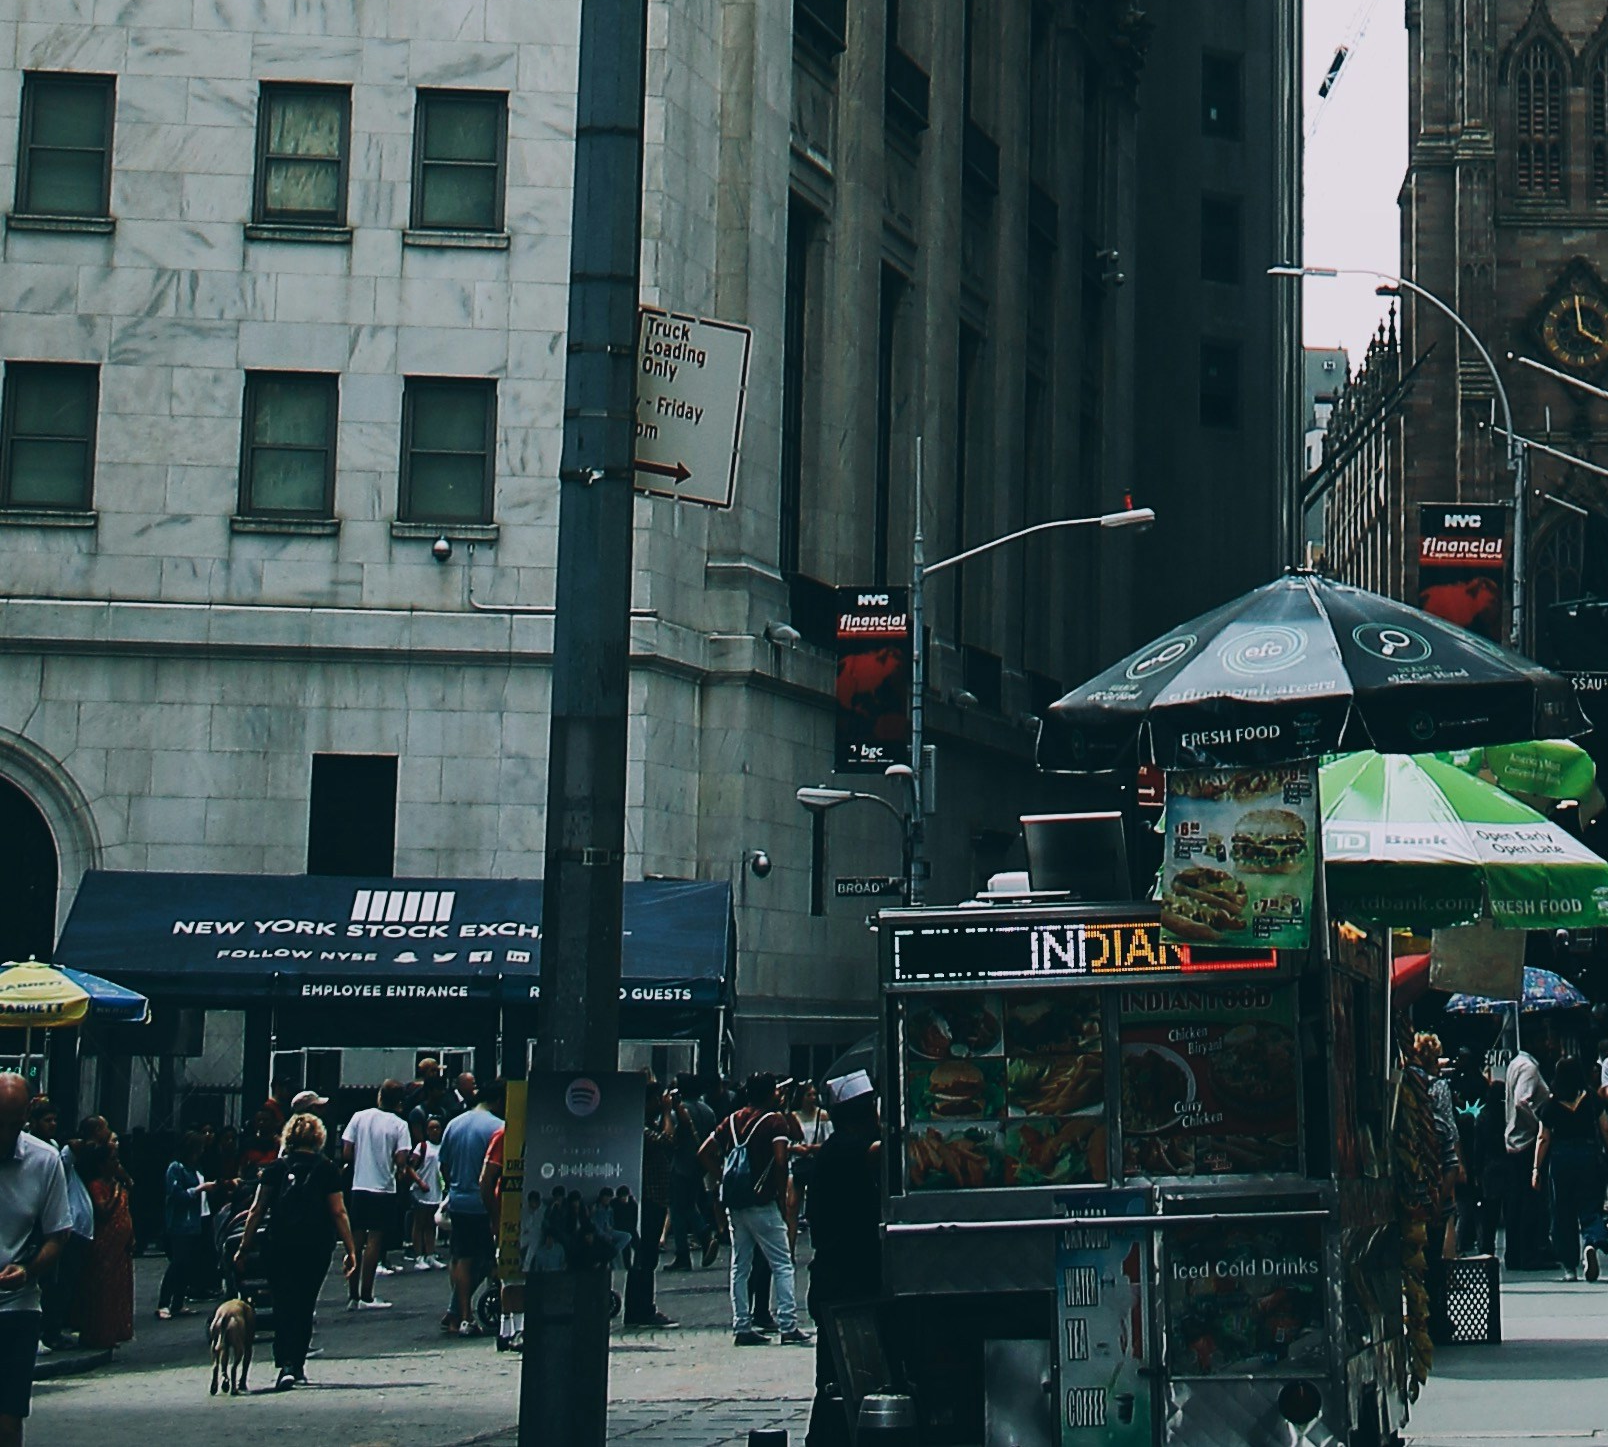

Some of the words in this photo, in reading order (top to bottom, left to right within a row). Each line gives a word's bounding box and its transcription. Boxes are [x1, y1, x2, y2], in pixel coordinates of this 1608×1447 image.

[647, 316, 690, 342] Truck
[644, 336, 707, 369] Loading
[642, 356, 678, 383] Only
[656, 396, 704, 426] Friday
[1443, 513, 1482, 528] NYC
[1422, 536, 1503, 556] financial
[857, 594, 889, 607] NYC
[840, 613, 907, 631] financial
[1567, 677, 1603, 691] SSAU
[1181, 729, 1233, 748] FRESH
[1235, 724, 1281, 741] FOOD
[861, 743, 884, 759] bgc
[1332, 832, 1367, 851] TD
[1385, 834, 1449, 846] Bank
[1477, 829, 1516, 843] Open
[1517, 830, 1554, 844] Early
[1492, 842, 1531, 856] Open
[1532, 842, 1566, 855] Late
[837, 882, 881, 894] BROAD
[1491, 899, 1536, 915] FRESH
[1539, 897, 1583, 914] FOOD
[172, 919, 245, 937] NEW
[253, 918, 337, 937] YORK
[346, 923, 450, 939] STOCK
[459, 922, 543, 940] EXCH
[215, 948, 314, 960] FOLLOW
[319, 951, 379, 963] NYSE
[301, 983, 383, 999] EMPLOYEE
[386, 983, 469, 998] ENTRANCE
[631, 986, 693, 1002] GUESTS
[1120, 989, 1203, 1014] INDIAN
[1206, 986, 1274, 1010] FOOD
[1168, 1025, 1209, 1043] Chicken
[1187, 1036, 1224, 1055] Biryani
[1173, 1100, 1203, 1115] Curry
[1181, 1111, 1224, 1129] Chicken
[1173, 1261, 1210, 1280] Iced
[1215, 1259, 1256, 1277] Cold
[1261, 1256, 1319, 1276] Drinks
[1065, 1266, 1100, 1307] WATER
[1066, 1317, 1089, 1360] TEA
[1066, 1386, 1107, 1428] COFFEE
